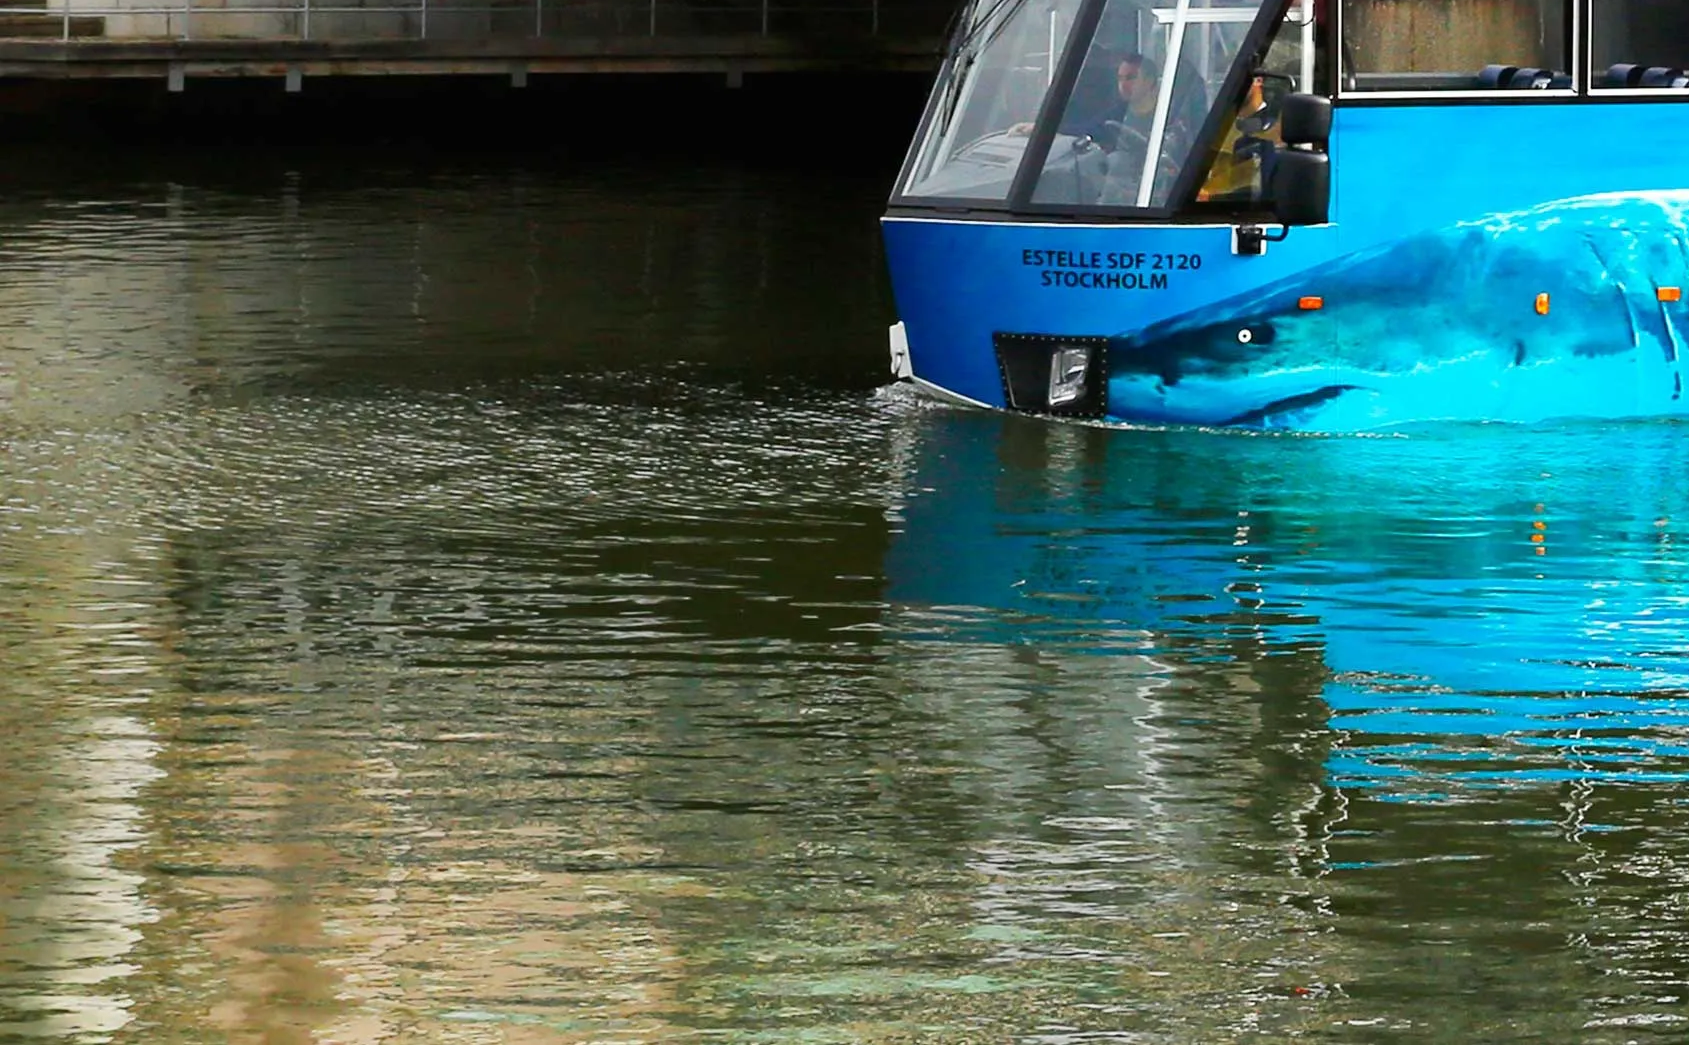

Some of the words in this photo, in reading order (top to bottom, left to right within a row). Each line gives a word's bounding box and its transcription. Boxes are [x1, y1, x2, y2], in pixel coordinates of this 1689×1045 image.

[1021, 249, 1101, 269] ESTELLE
[1107, 253, 1146, 270] SDF
[1152, 254, 1202, 270] 2120
[1041, 270, 1168, 290] STOCKHOLM
